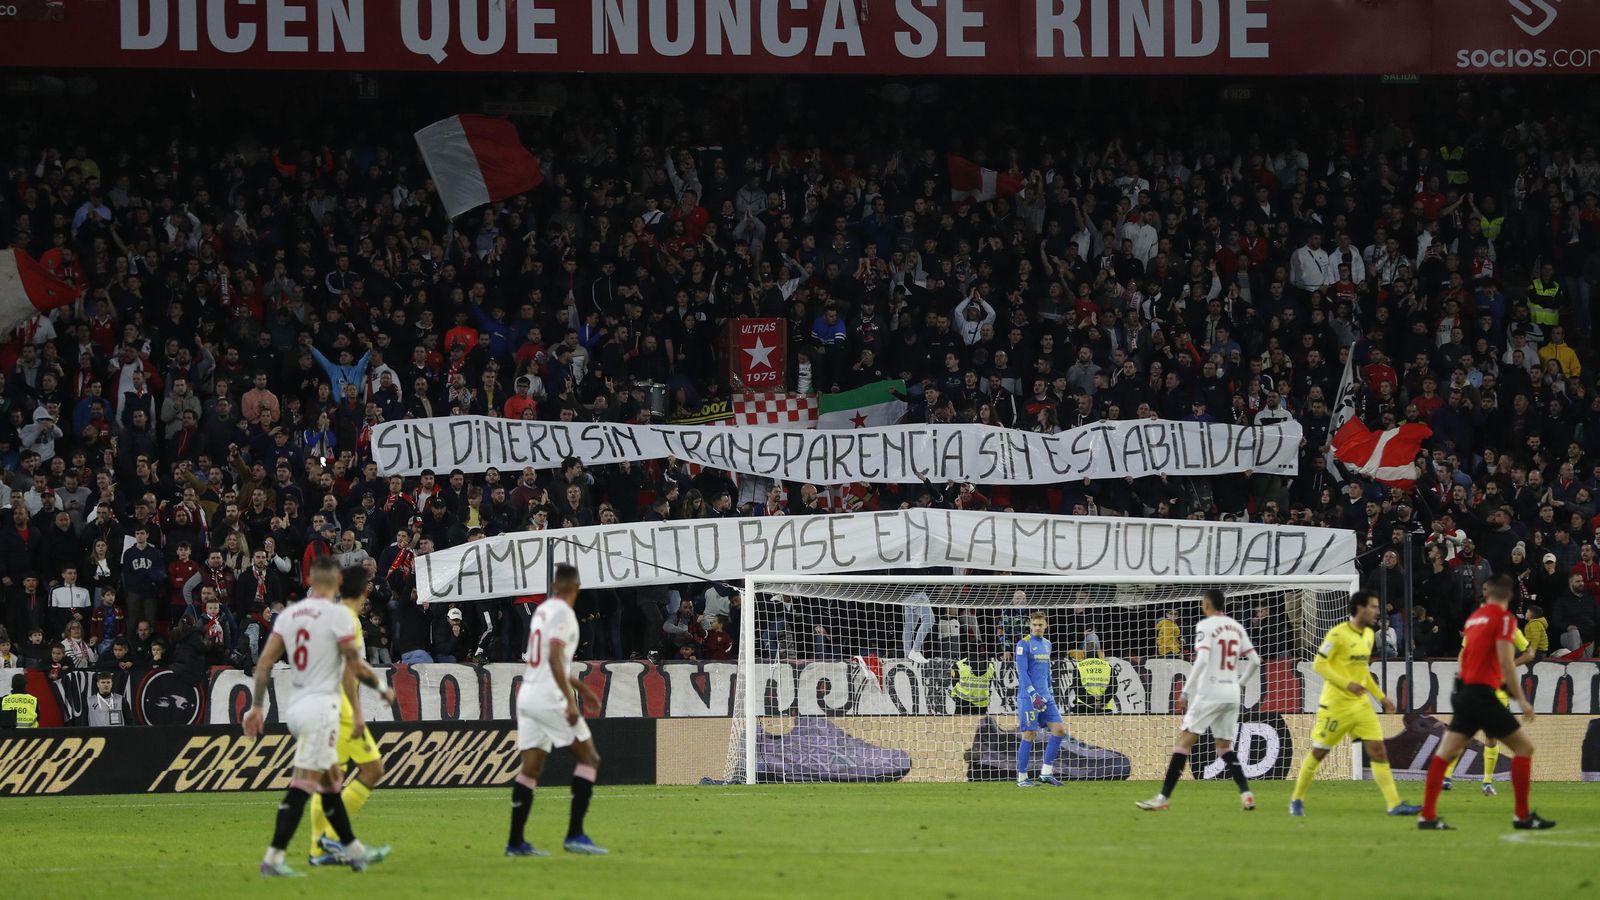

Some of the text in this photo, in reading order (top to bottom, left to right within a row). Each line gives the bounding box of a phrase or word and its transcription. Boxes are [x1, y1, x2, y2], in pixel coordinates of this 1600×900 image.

[120, 0, 1269, 63] DICEN QUE NUNCA SE RINDE
[741, 322, 777, 334] ULTRAS
[746, 371, 777, 382] 1975
[693, 401, 728, 417] 007
[738, 514, 857, 572] BASE
[873, 511, 929, 563] EN
[944, 511, 997, 566] LA
[132, 557, 153, 570] GAP
[293, 627, 310, 672] 6
[529, 628, 542, 668] 0
[1217, 639, 1238, 671] 15
[4, 697, 35, 706] SEGURIDAD
[1024, 711, 1036, 722] 13
[1324, 716, 1338, 733] 10
[147, 734, 297, 792] FOREVE
